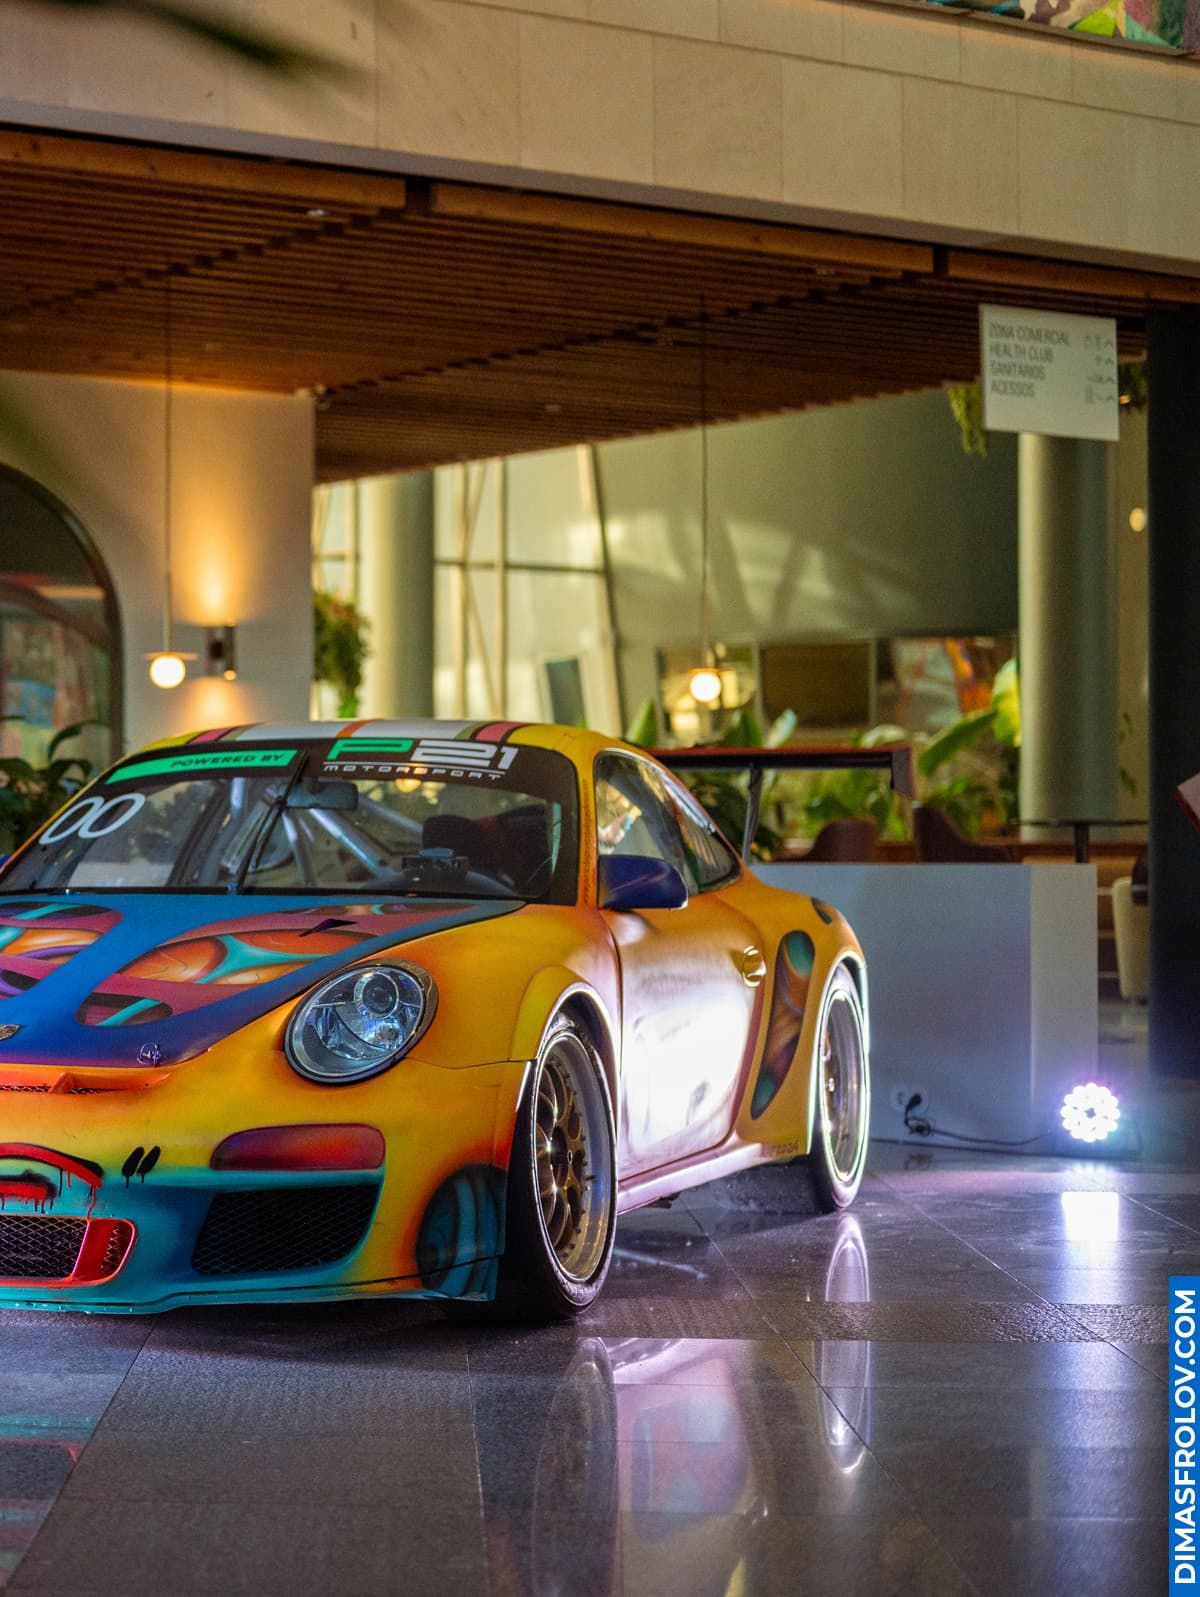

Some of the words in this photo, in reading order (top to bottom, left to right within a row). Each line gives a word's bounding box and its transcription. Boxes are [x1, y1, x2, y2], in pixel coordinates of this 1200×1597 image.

[170, 754, 256, 768] POWERED
[260, 753, 285, 762] BY
[326, 738, 519, 770] P21
[324, 764, 503, 781] MOTORSPORT
[39, 793, 146, 845] 00
